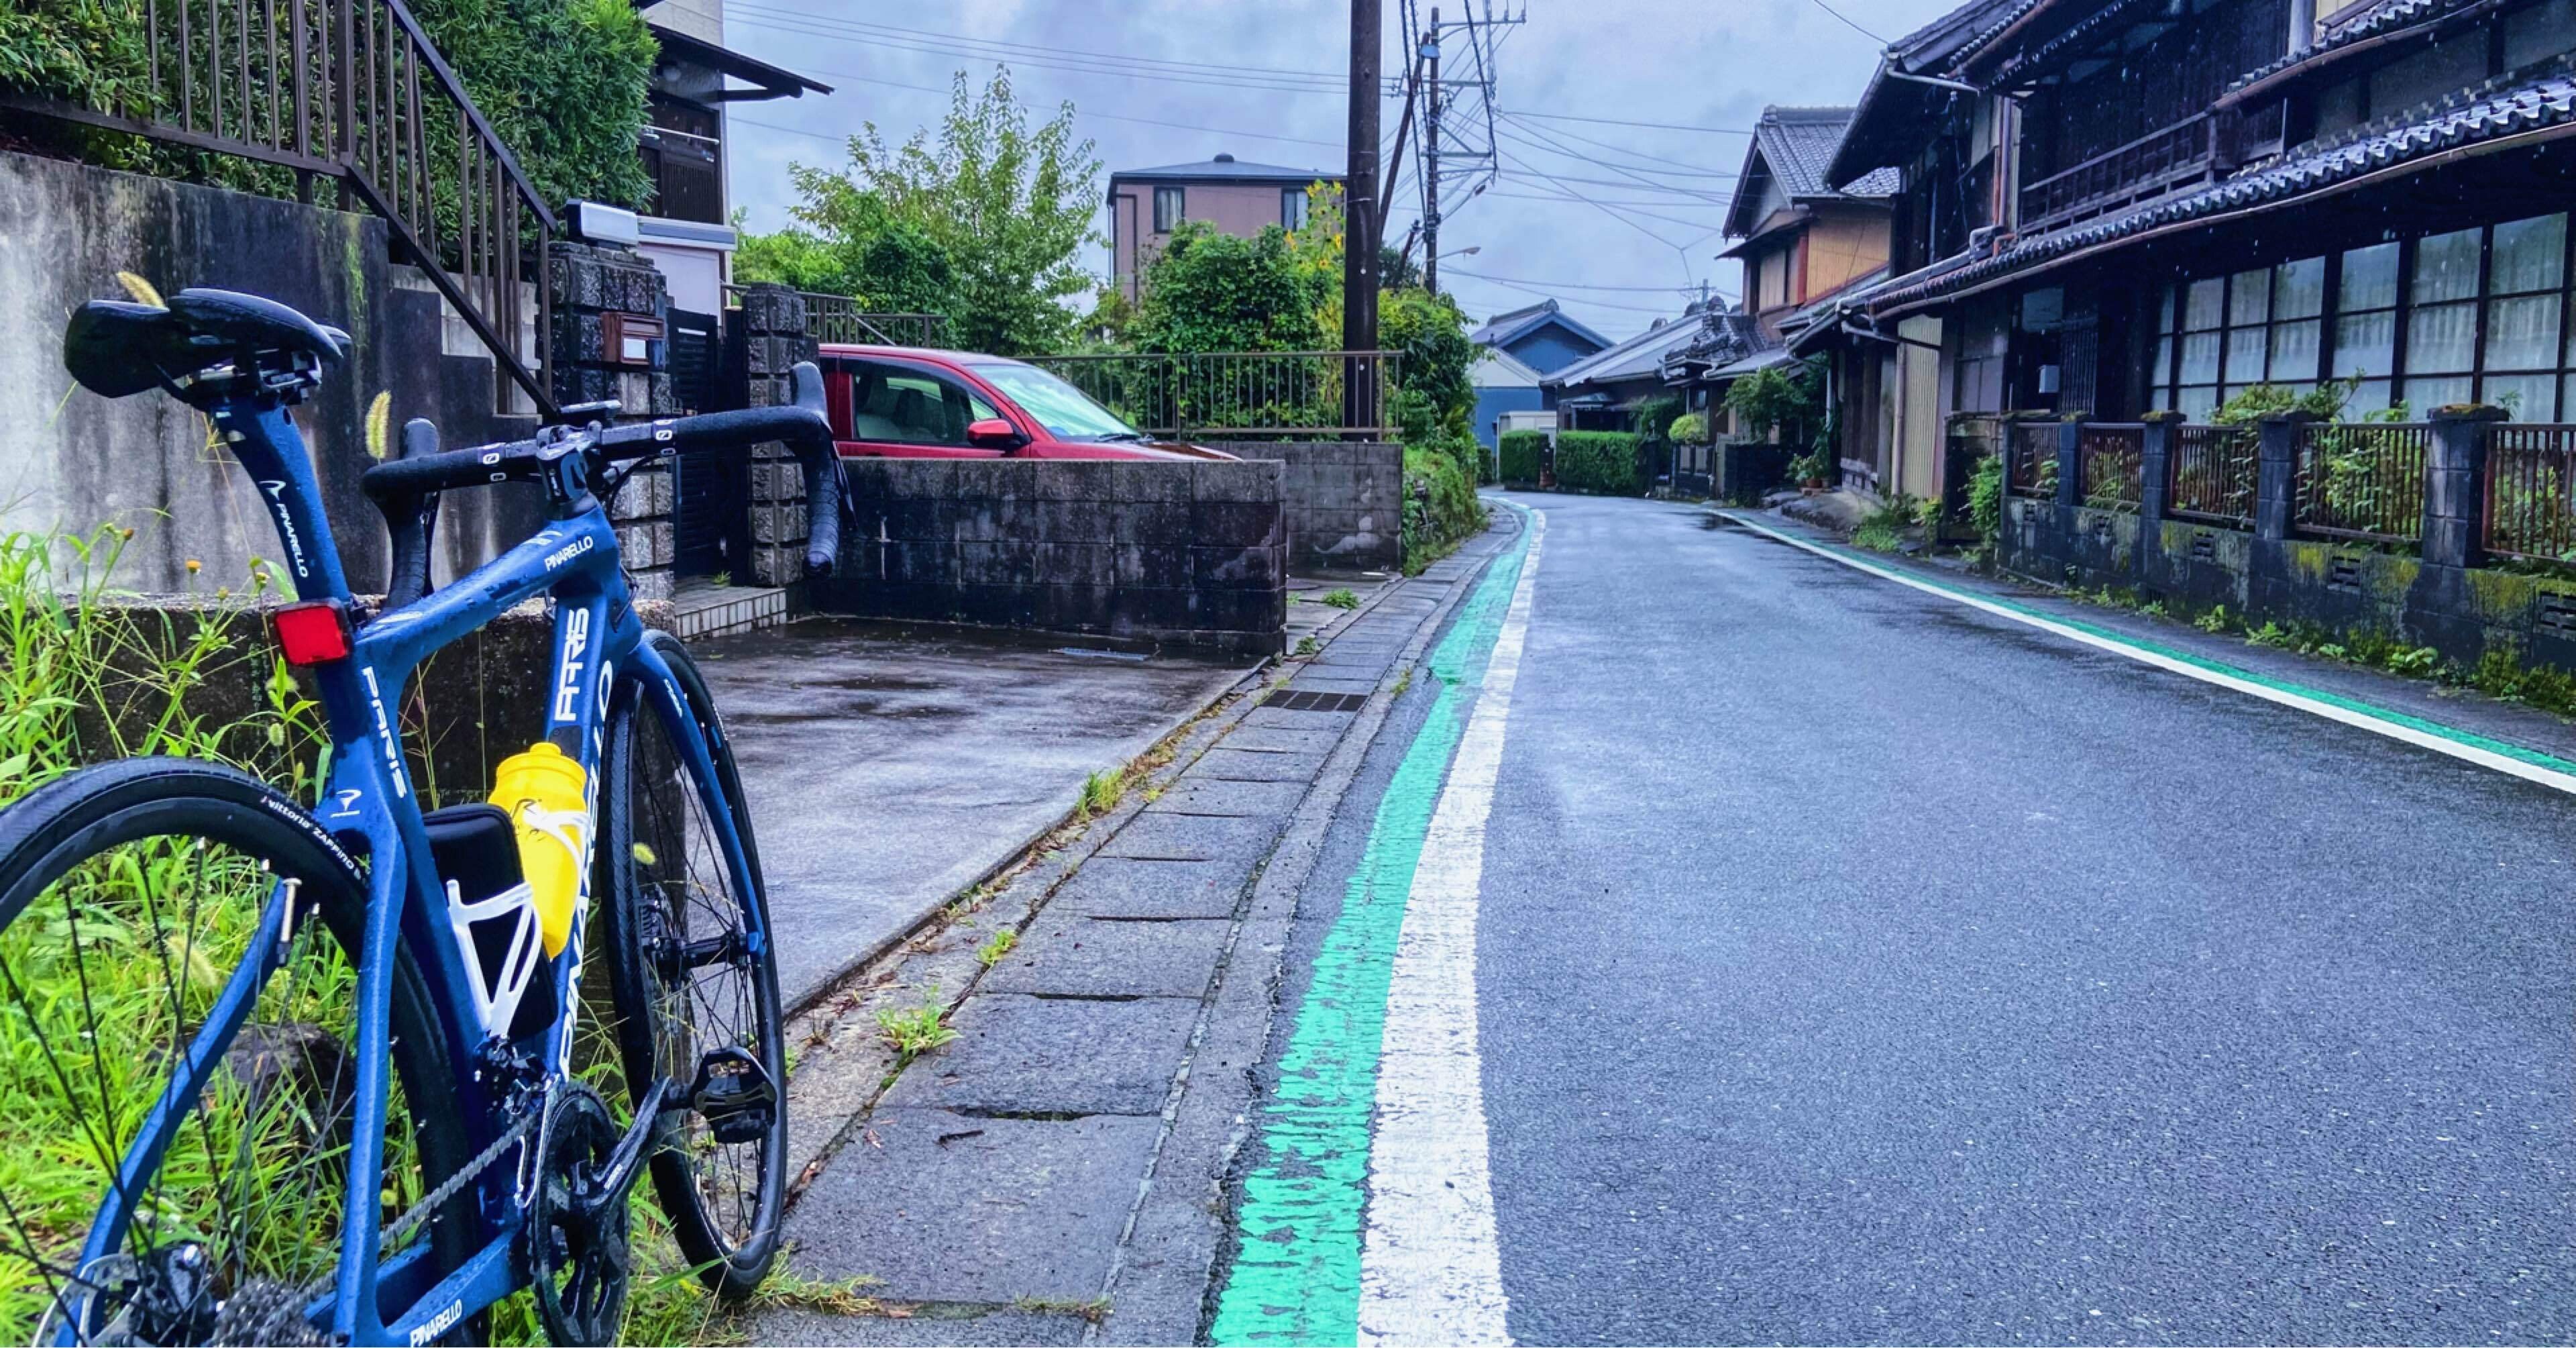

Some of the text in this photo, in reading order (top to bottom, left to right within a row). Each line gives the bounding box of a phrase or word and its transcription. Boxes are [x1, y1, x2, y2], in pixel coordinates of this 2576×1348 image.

[276, 503, 309, 578] PINARELLO
[544, 535, 594, 572] PINARELLO
[411, 1298, 462, 1347] PINARELLO
